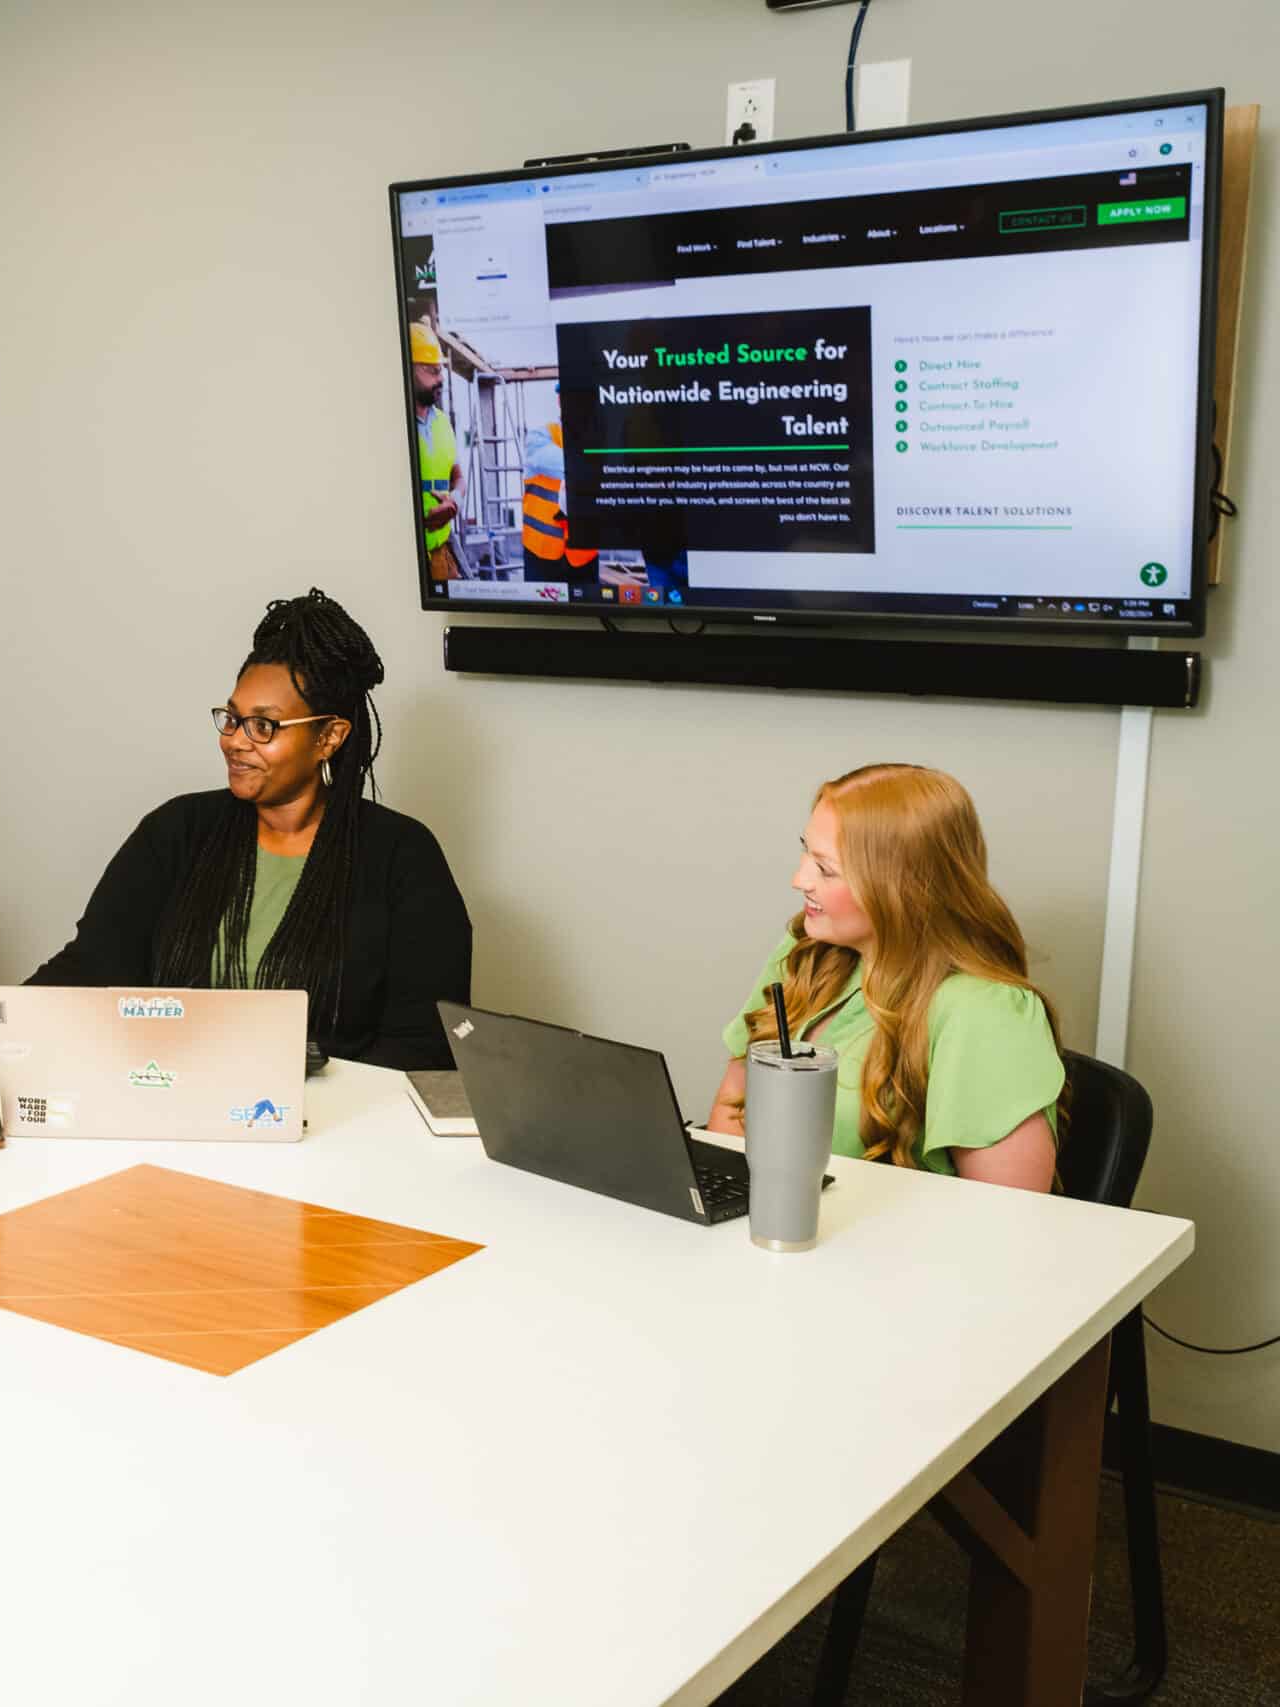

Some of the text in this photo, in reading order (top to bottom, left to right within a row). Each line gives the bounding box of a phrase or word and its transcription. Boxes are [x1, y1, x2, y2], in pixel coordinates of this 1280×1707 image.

[1110, 204, 1173, 217] APPLY NOW
[1010, 215, 1056, 226] CONTACT
[867, 229, 891, 238] About
[919, 223, 958, 234] Locations
[736, 238, 776, 249] Find Talent
[803, 233, 840, 243] Industries
[677, 243, 711, 253] Find Work
[603, 338, 847, 368] Your Trusted Source for
[919, 358, 982, 371] Direct Hire
[919, 376, 1019, 392] Contract Staffing
[599, 379, 848, 404] Nationwide Engineering
[781, 414, 849, 436] Talent
[920, 418, 1030, 432] Outsourced Payroll
[920, 439, 1058, 452] Workforce Development
[603, 465, 634, 473] Electrical
[637, 465, 672, 475] engineers
[674, 466, 690, 475] may
[691, 464, 701, 473] be
[703, 464, 720, 473] hard
[722, 465, 731, 473] to
[732, 465, 754, 473] come
[768, 464, 782, 473] but
[783, 464, 798, 473] not
[799, 464, 808, 473] at
[833, 463, 850, 472] Our
[600, 480, 851, 491] extensive network of industry professionals across the country are
[596, 497, 616, 507] ready
[617, 497, 626, 505] to
[627, 497, 645, 505] work
[646, 496, 657, 505] for
[676, 497, 688, 505] We
[689, 497, 717, 507] recruit,
[718, 497, 733, 505] and
[734, 497, 761, 505] screen
[762, 496, 775, 505] the
[776, 496, 794, 505] best
[795, 496, 804, 505] of
[805, 496, 820, 505] the
[821, 496, 839, 505] best
[840, 497, 851, 505] so
[779, 513, 795, 523] you
[796, 512, 817, 521] don't
[818, 511, 838, 521] have
[896, 507, 1072, 516] DISCOVER TALENT SOLUTIONS
[124, 1007, 183, 1016] MATTER
[17, 1096, 47, 1104] WORK
[19, 1103, 47, 1111] HARD
